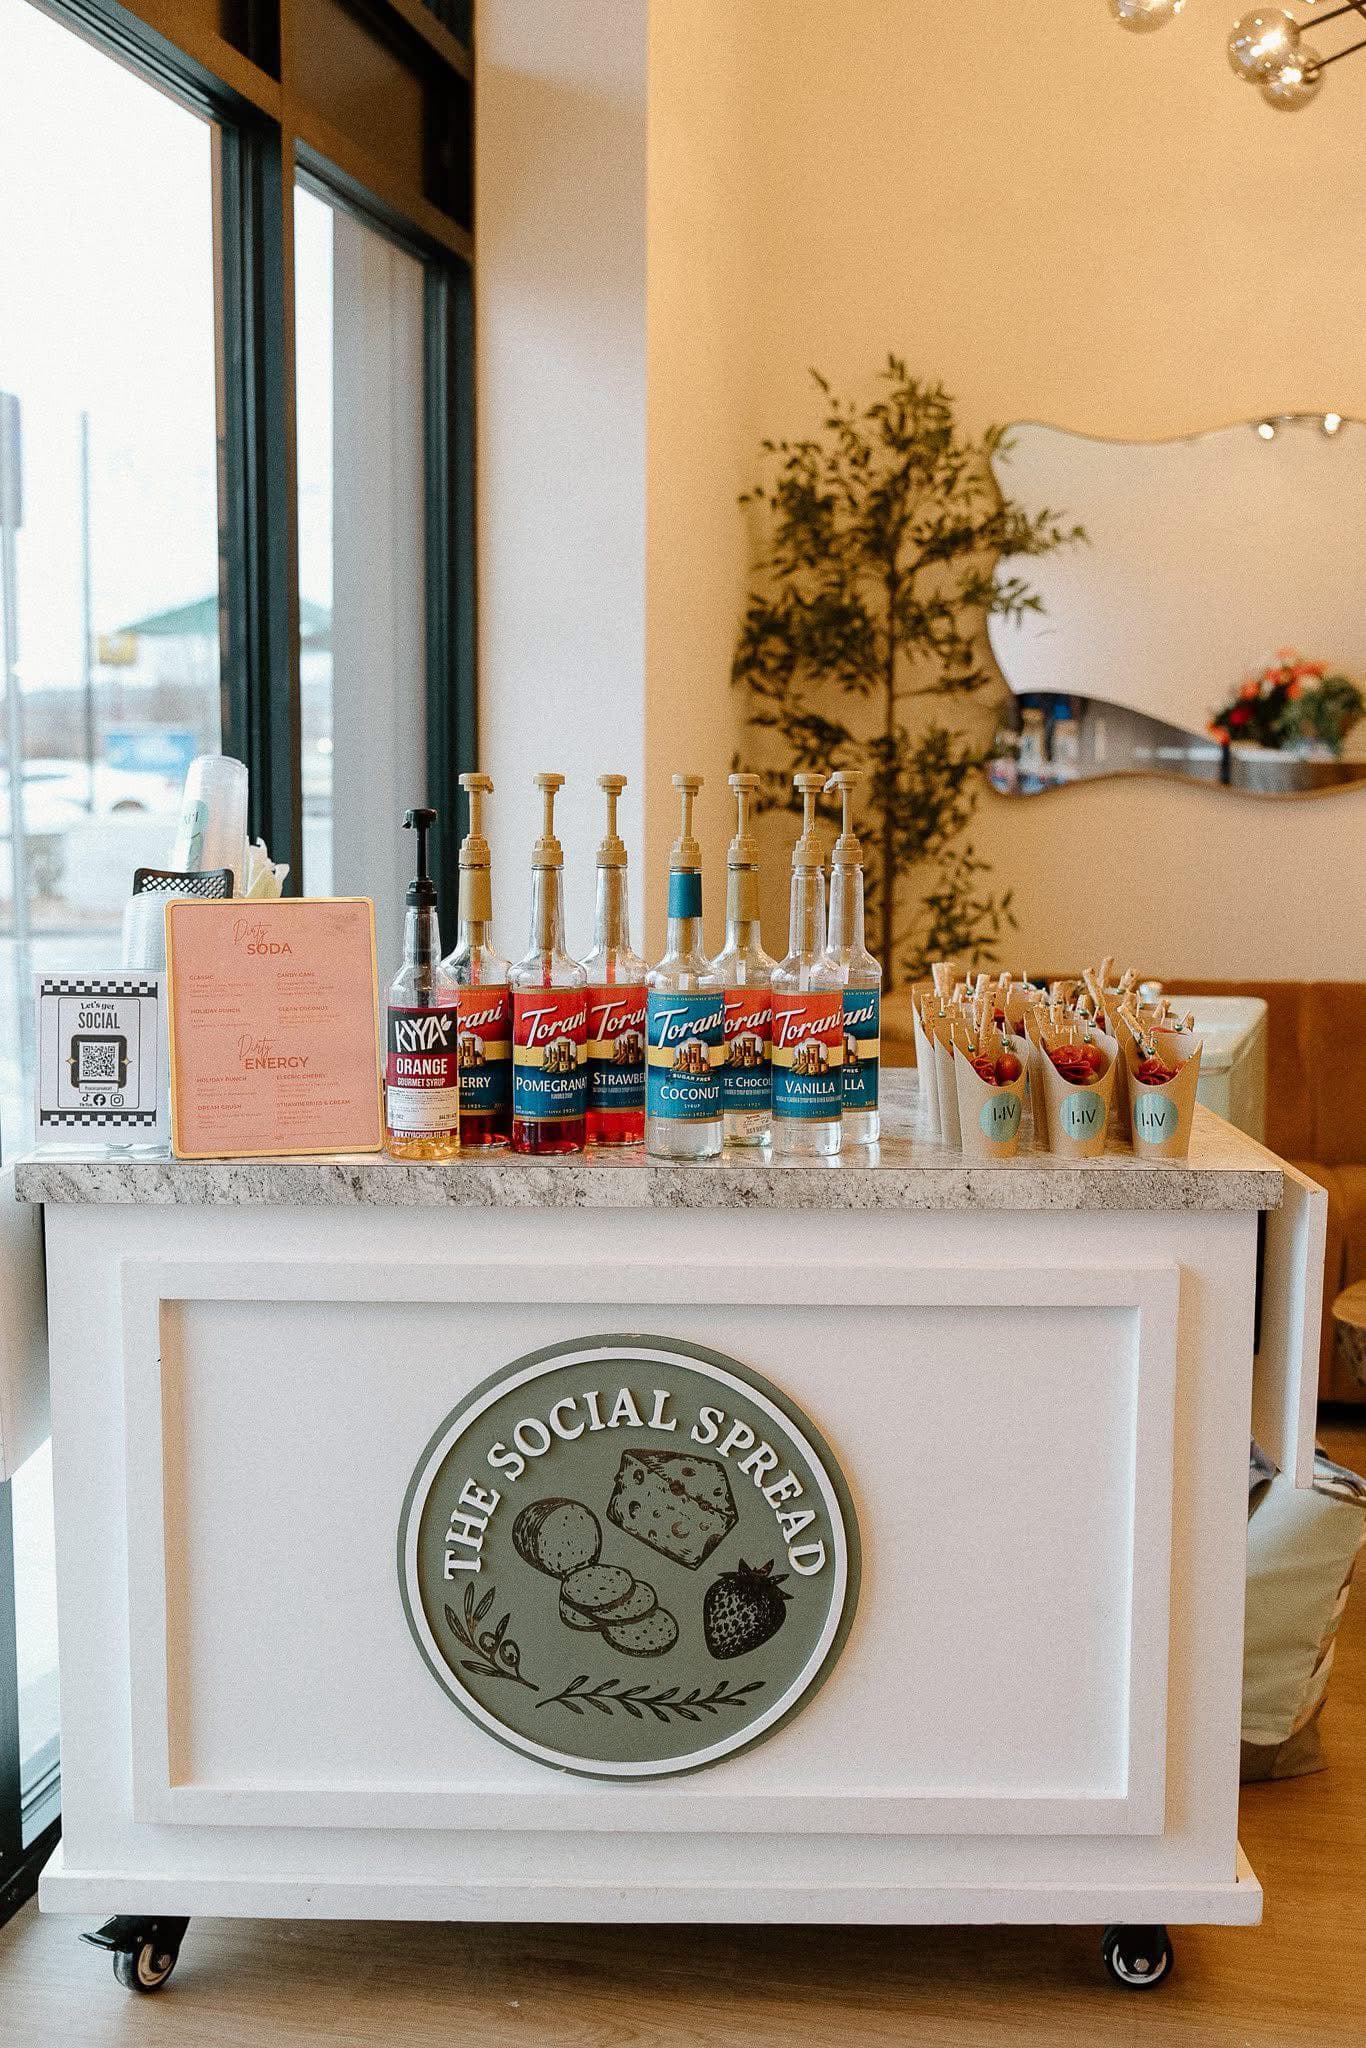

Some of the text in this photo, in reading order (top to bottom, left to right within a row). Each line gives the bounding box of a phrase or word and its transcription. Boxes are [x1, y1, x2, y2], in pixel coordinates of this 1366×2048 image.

[247, 943, 292, 955] SODA
[78, 1012, 120, 1029] SOCIAL
[654, 1004, 723, 1049] Torani
[776, 1004, 842, 1050] Torani
[245, 1056, 309, 1070] ENERGY
[396, 1058, 448, 1075] ORANGE
[397, 1078, 446, 1087] GOURMET SYRUP
[672, 1073, 695, 1081] SUGAR
[660, 1086, 719, 1100] COCONUT
[785, 1080, 835, 1094] VANILLA
[444, 1387, 827, 1581] THE SOCIAL SPREAD
